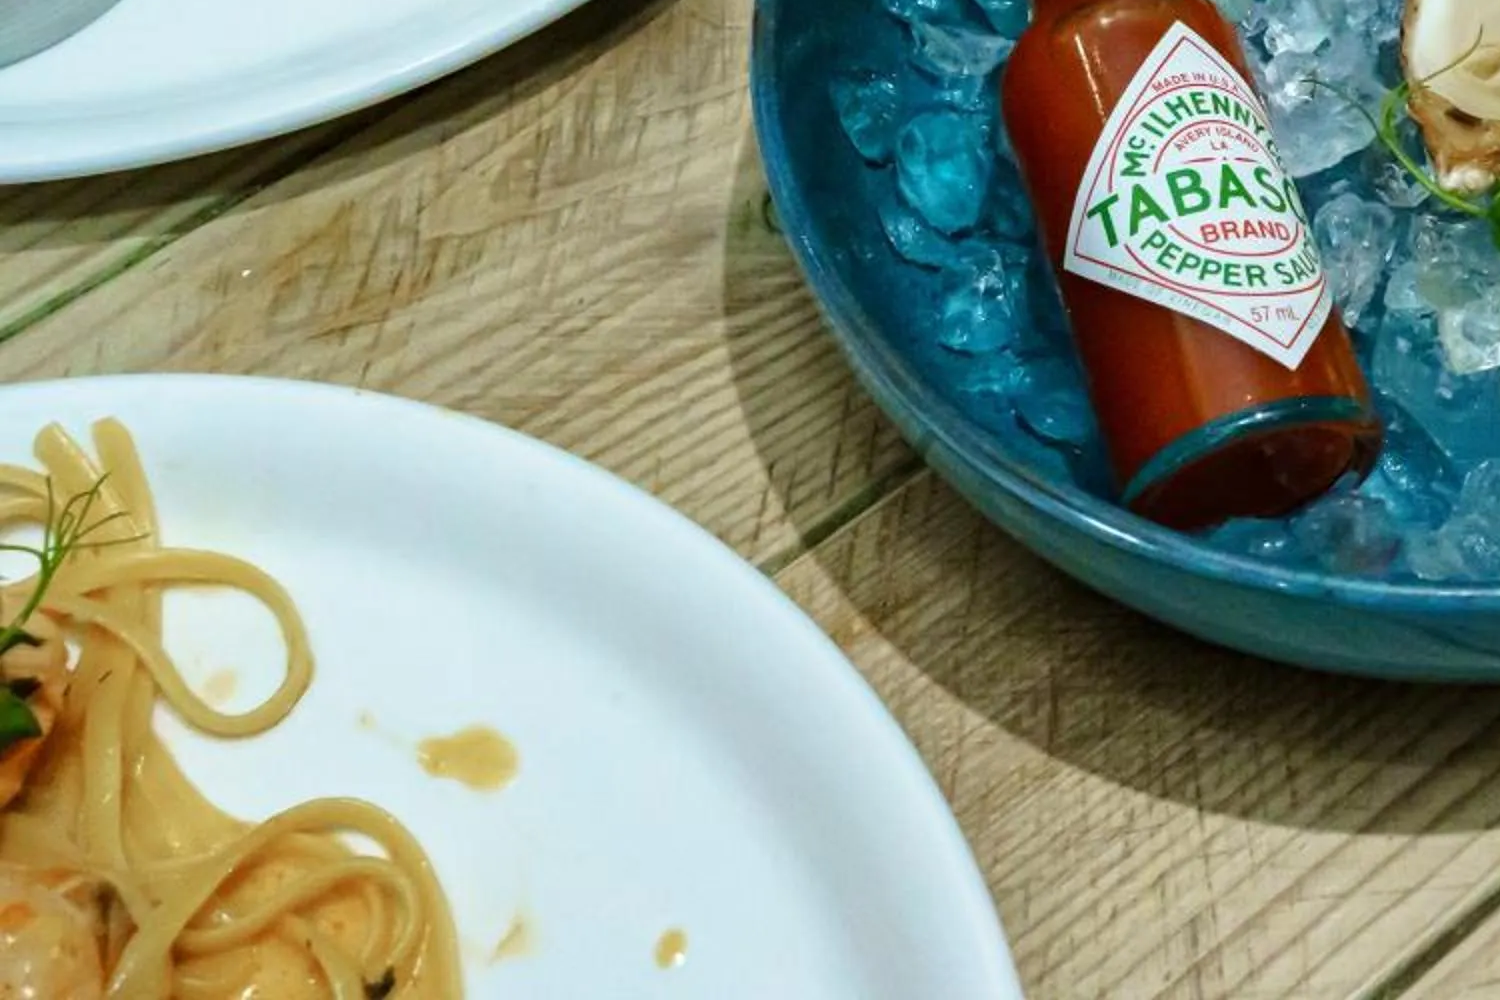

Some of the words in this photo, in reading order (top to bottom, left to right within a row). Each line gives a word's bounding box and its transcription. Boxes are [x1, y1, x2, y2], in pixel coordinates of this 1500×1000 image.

[1152, 72, 1191, 93] MADE
[1192, 72, 1205, 81] IN
[1173, 127, 1211, 152] AVERY
[1215, 127, 1259, 152] ISLAND
[1087, 163, 1308, 248] TABASC
[1200, 219, 1290, 243] BRAND
[1140, 229, 1267, 287] PEPPER
[1250, 305, 1269, 322] 57
